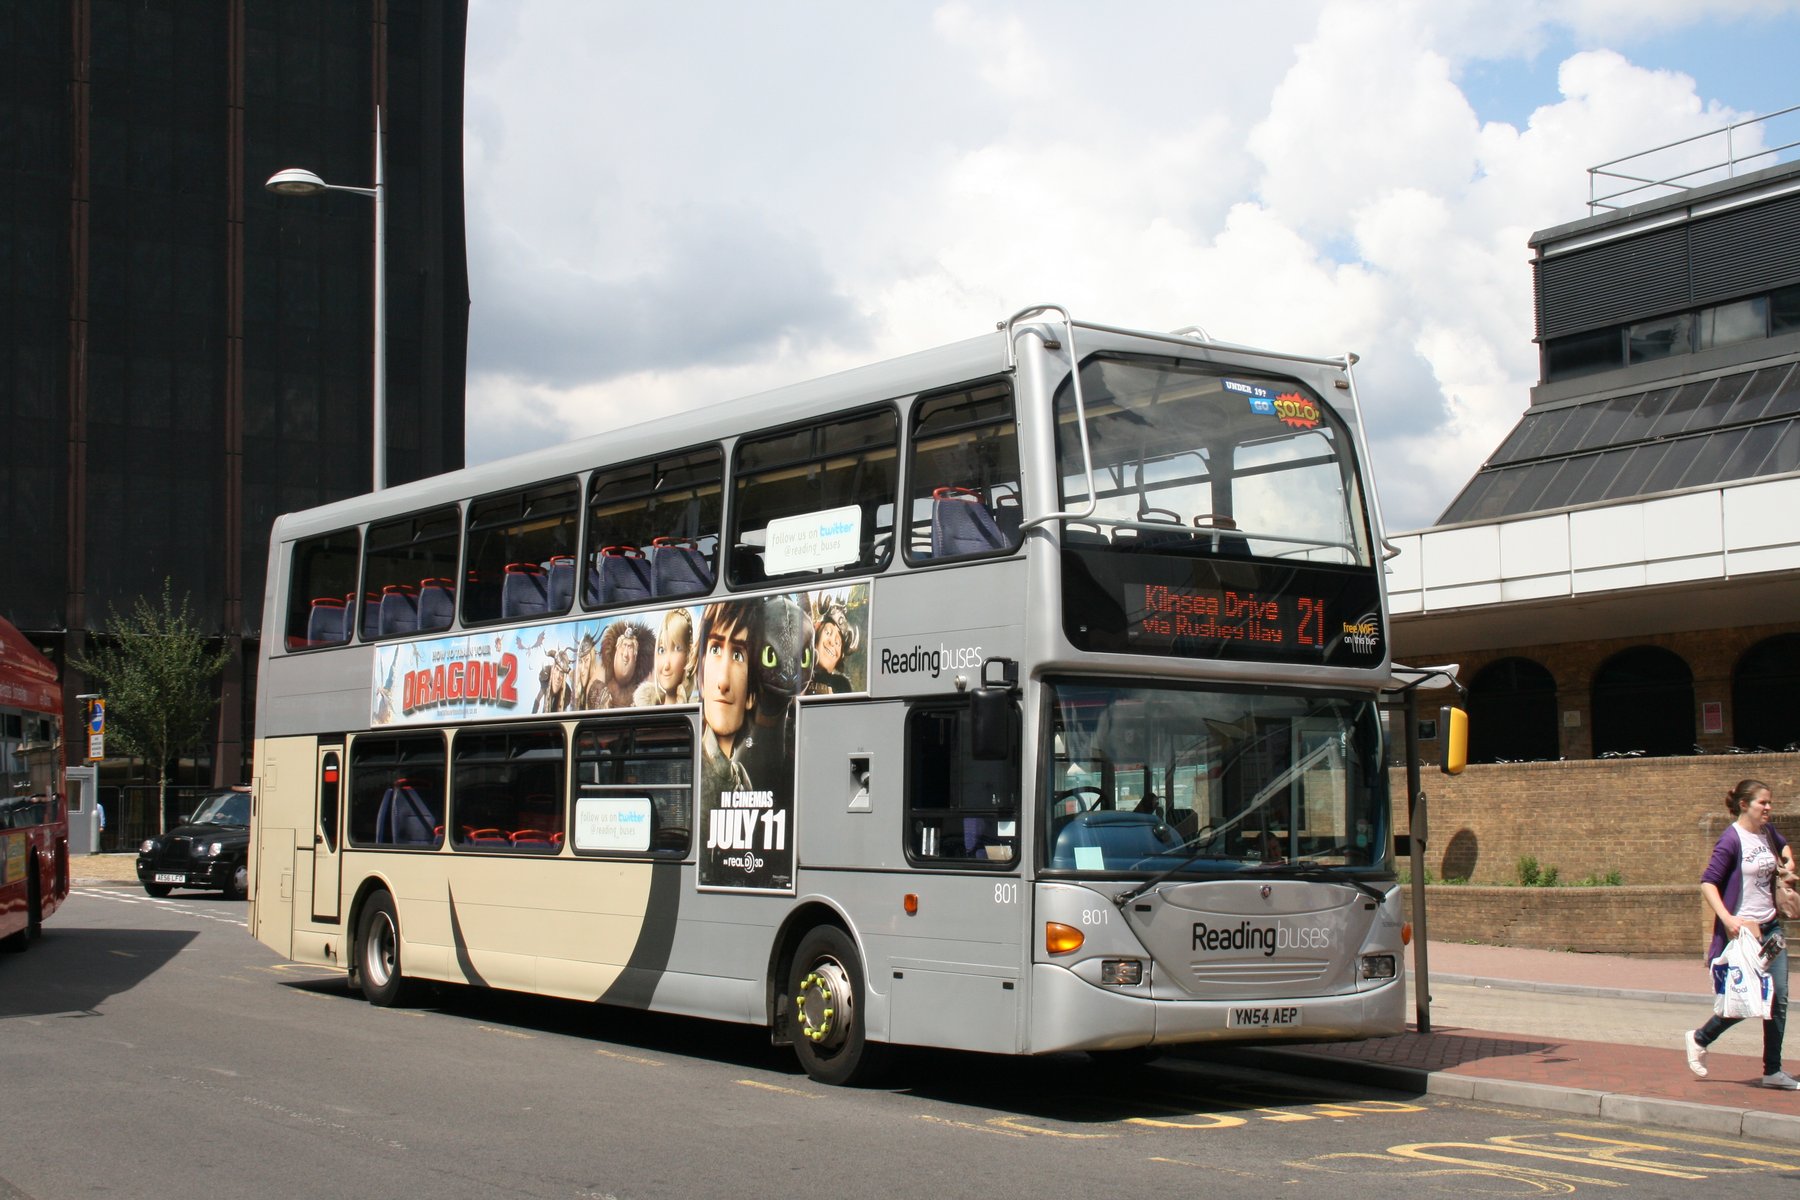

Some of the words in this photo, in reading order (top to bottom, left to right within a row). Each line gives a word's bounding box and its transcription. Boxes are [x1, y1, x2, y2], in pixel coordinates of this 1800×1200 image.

[1225, 381, 1252, 394] UNDER
[1254, 387, 1267, 397] 19?
[1253, 400, 1270, 411] GO
[1273, 400, 1319, 423] SOLO!
[772, 532, 796, 547] follow
[798, 532, 806, 541] us
[808, 529, 818, 539] on
[819, 522, 854, 537] twitter
[1225, 591, 1279, 620] Drive
[1297, 597, 1324, 645] 21
[1343, 621, 1357, 633] free
[1143, 615, 1171, 635] via
[1248, 620, 1283, 642] Way
[402, 660, 498, 714] DRAGON
[500, 652, 518, 706] 2
[720, 791, 732, 808] IN
[732, 790, 774, 808] CINEMAS
[580, 810, 600, 825] follow
[601, 814, 608, 822] us
[609, 813, 617, 822] on
[618, 811, 645, 823] twitter
[706, 809, 760, 850] JULY
[760, 809, 786, 850] 11
[755, 858, 764, 868] 3D
[994, 883, 1017, 904] 801
[1082, 909, 1109, 925] 801
[1235, 1008, 1270, 1025] YN54
[1273, 1007, 1298, 1024] AEP
